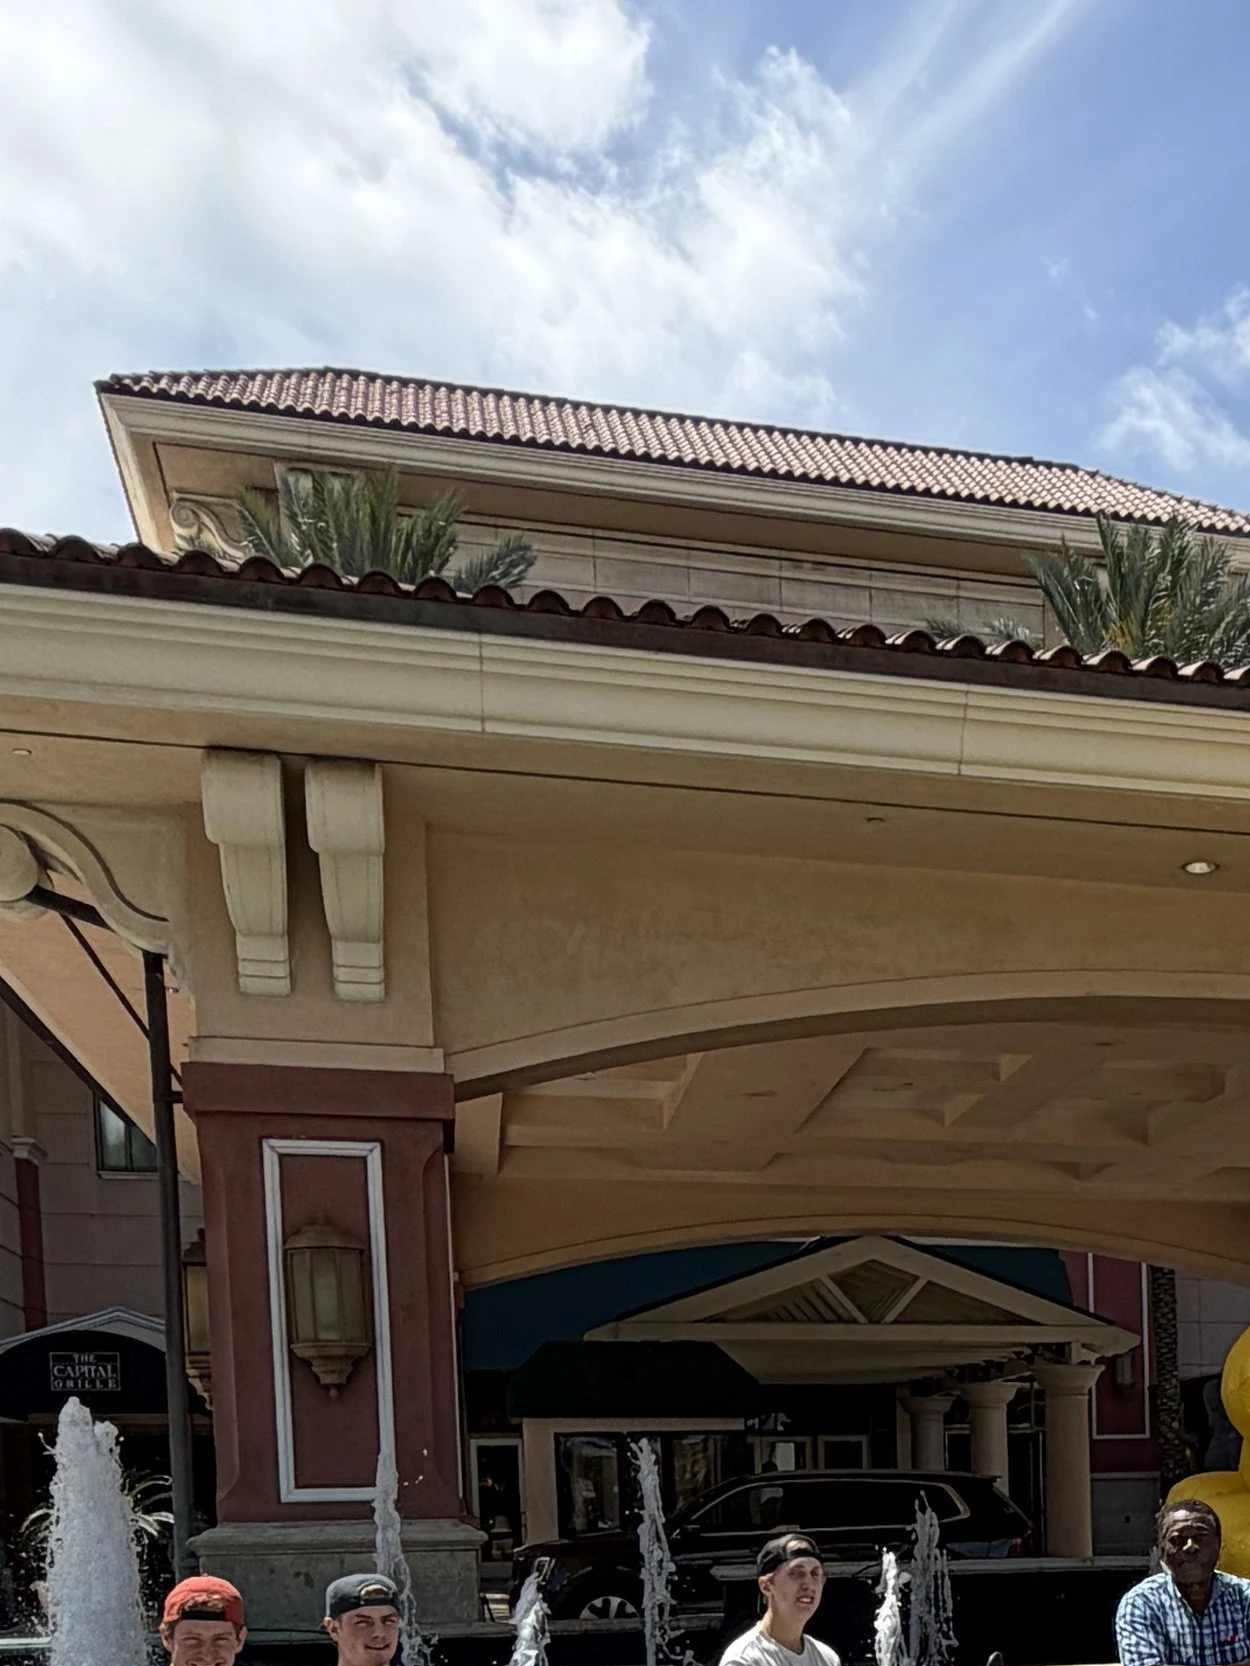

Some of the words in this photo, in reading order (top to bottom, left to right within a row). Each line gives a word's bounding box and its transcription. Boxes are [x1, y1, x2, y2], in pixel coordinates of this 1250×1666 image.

[73, 1352, 96, 1363] THE
[53, 1365, 117, 1378] CAPITAL
[54, 1379, 117, 1389] GRILLE
